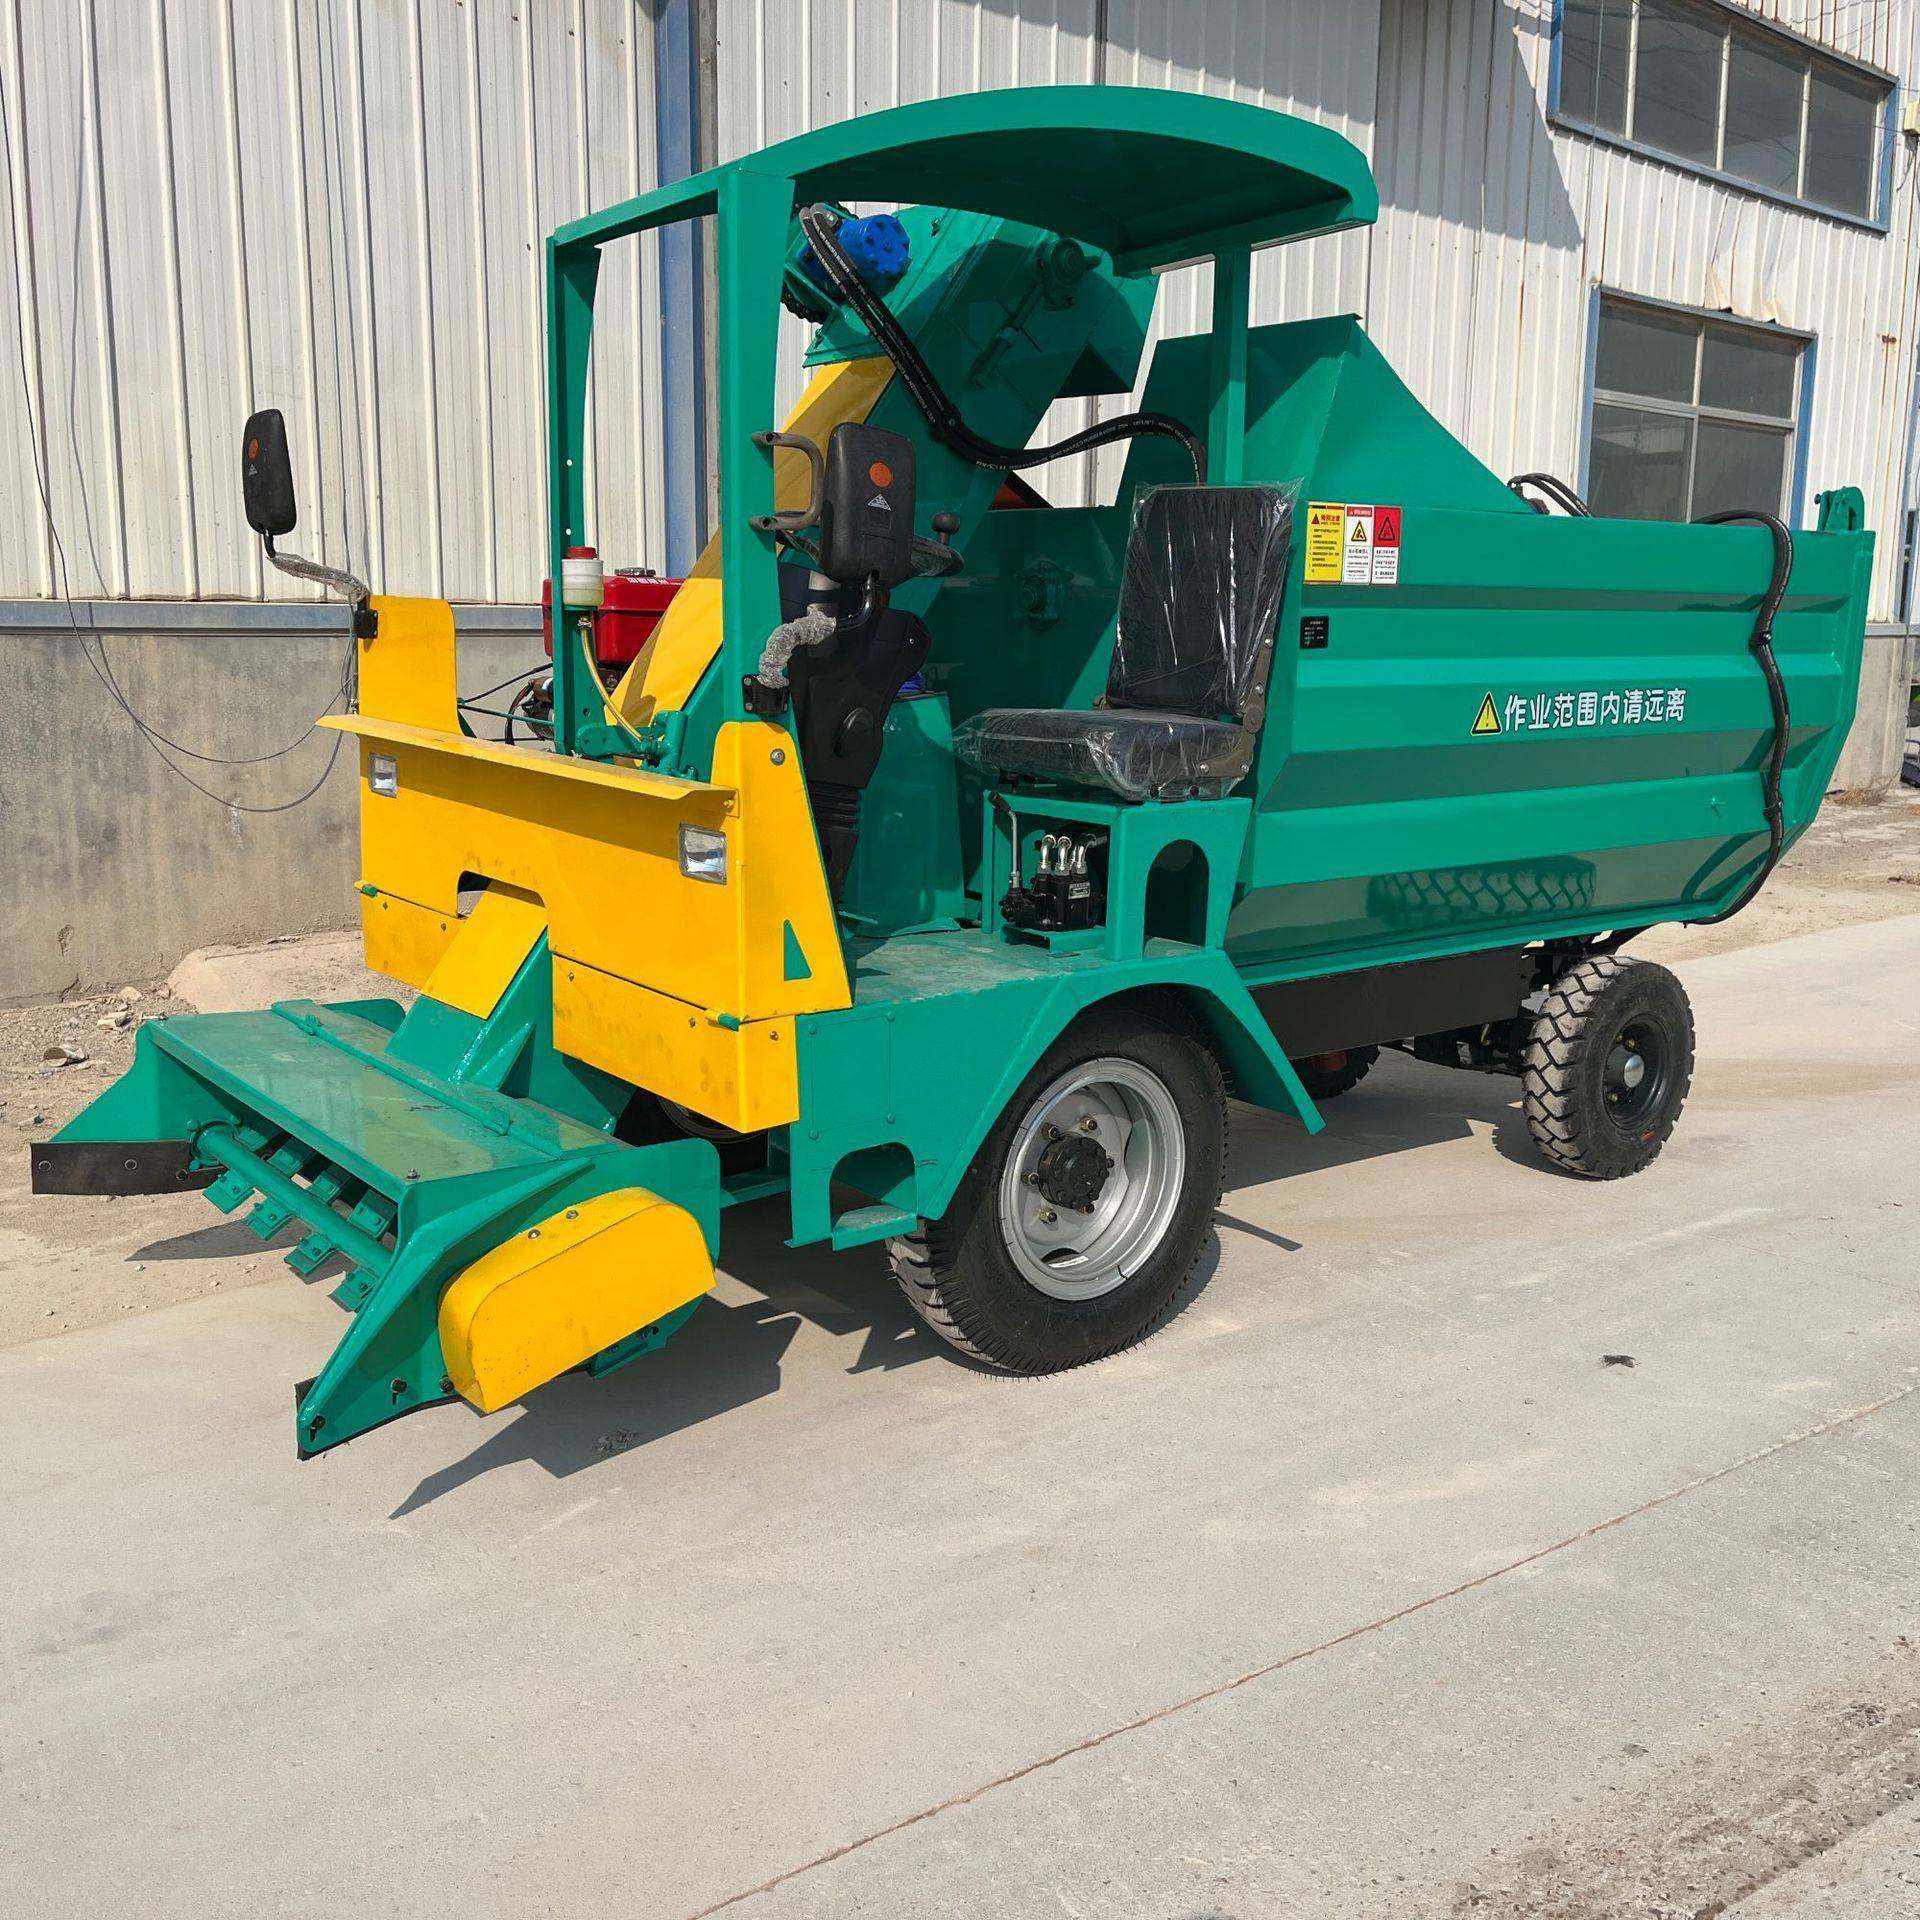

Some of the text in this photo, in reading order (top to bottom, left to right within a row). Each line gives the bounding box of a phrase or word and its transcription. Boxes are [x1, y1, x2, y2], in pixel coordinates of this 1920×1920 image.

[1504, 688, 1687, 731] 作业范围内请远离
